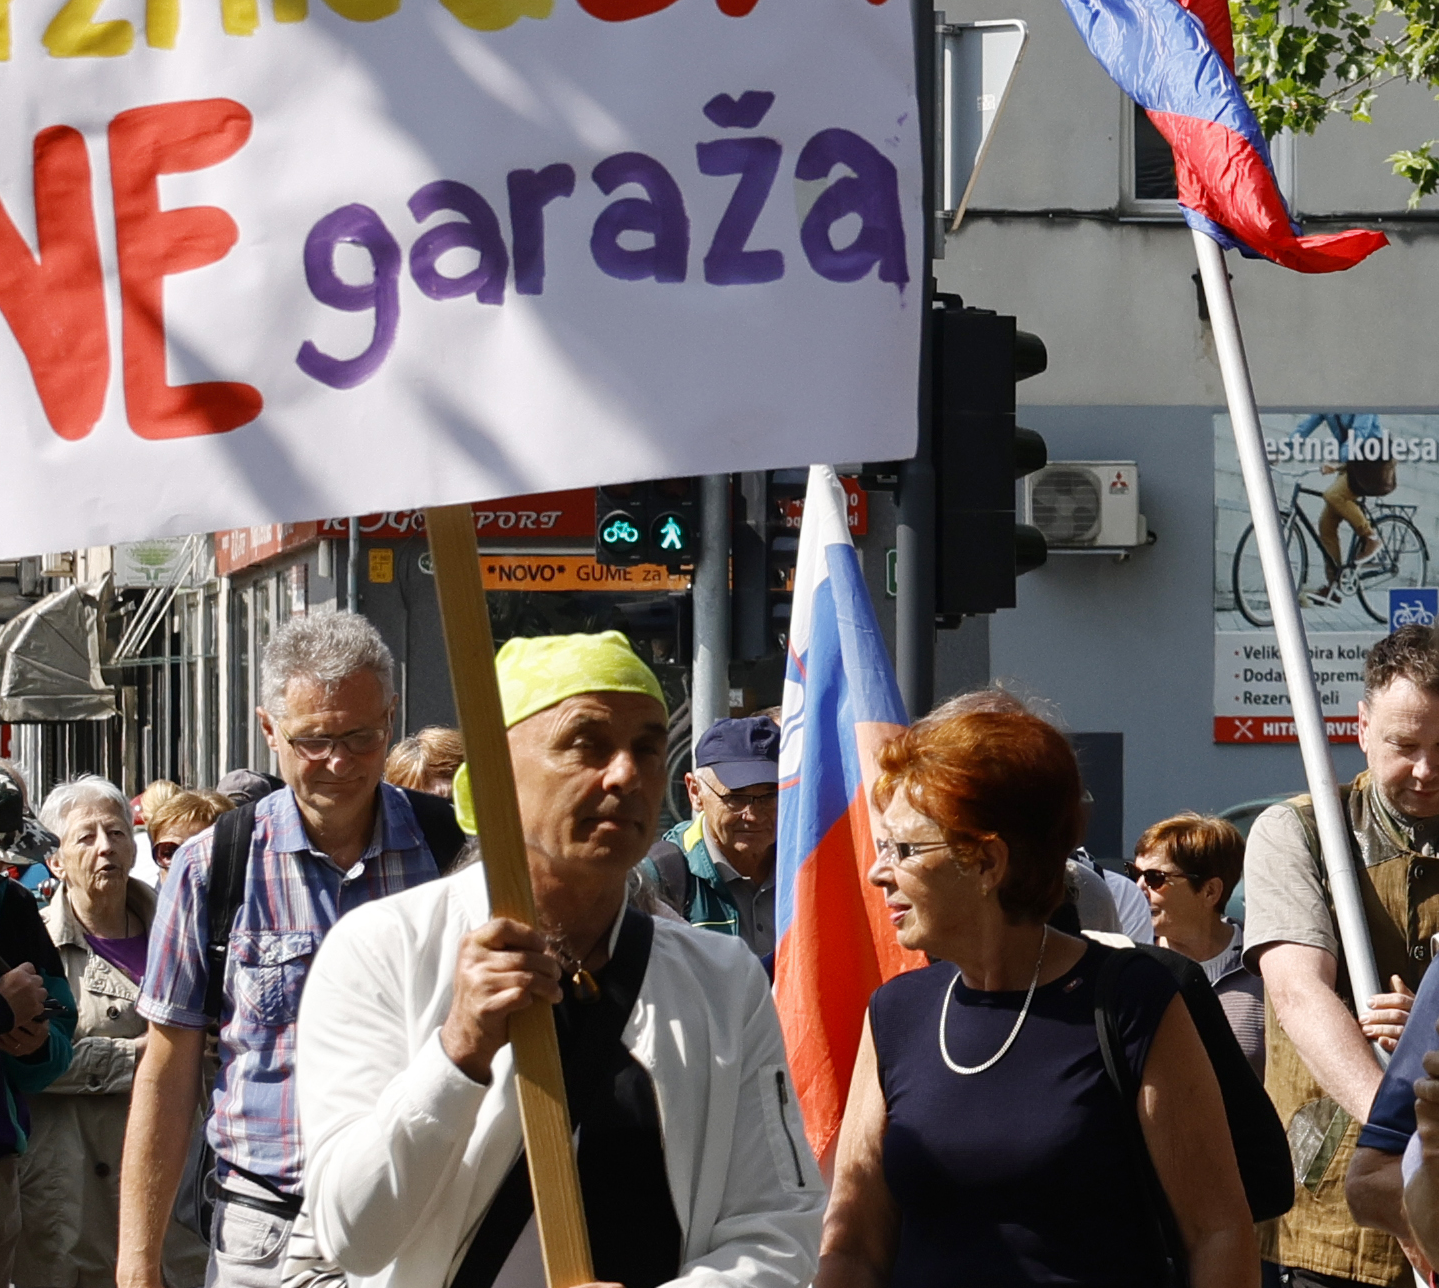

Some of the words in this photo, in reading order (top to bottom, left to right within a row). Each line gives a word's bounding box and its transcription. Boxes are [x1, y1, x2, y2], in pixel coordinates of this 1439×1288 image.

[295, 90, 911, 390] garaža
[1262, 435, 1340, 462] estna
[1348, 429, 1438, 462] kolesa
[471, 511, 562, 529] PORT
[577, 566, 632, 581] GUME
[643, 570, 661, 581] za
[1244, 646, 1281, 661] Velik
[1263, 722, 1297, 736] HITR
[1327, 722, 1358, 736] RVIS
